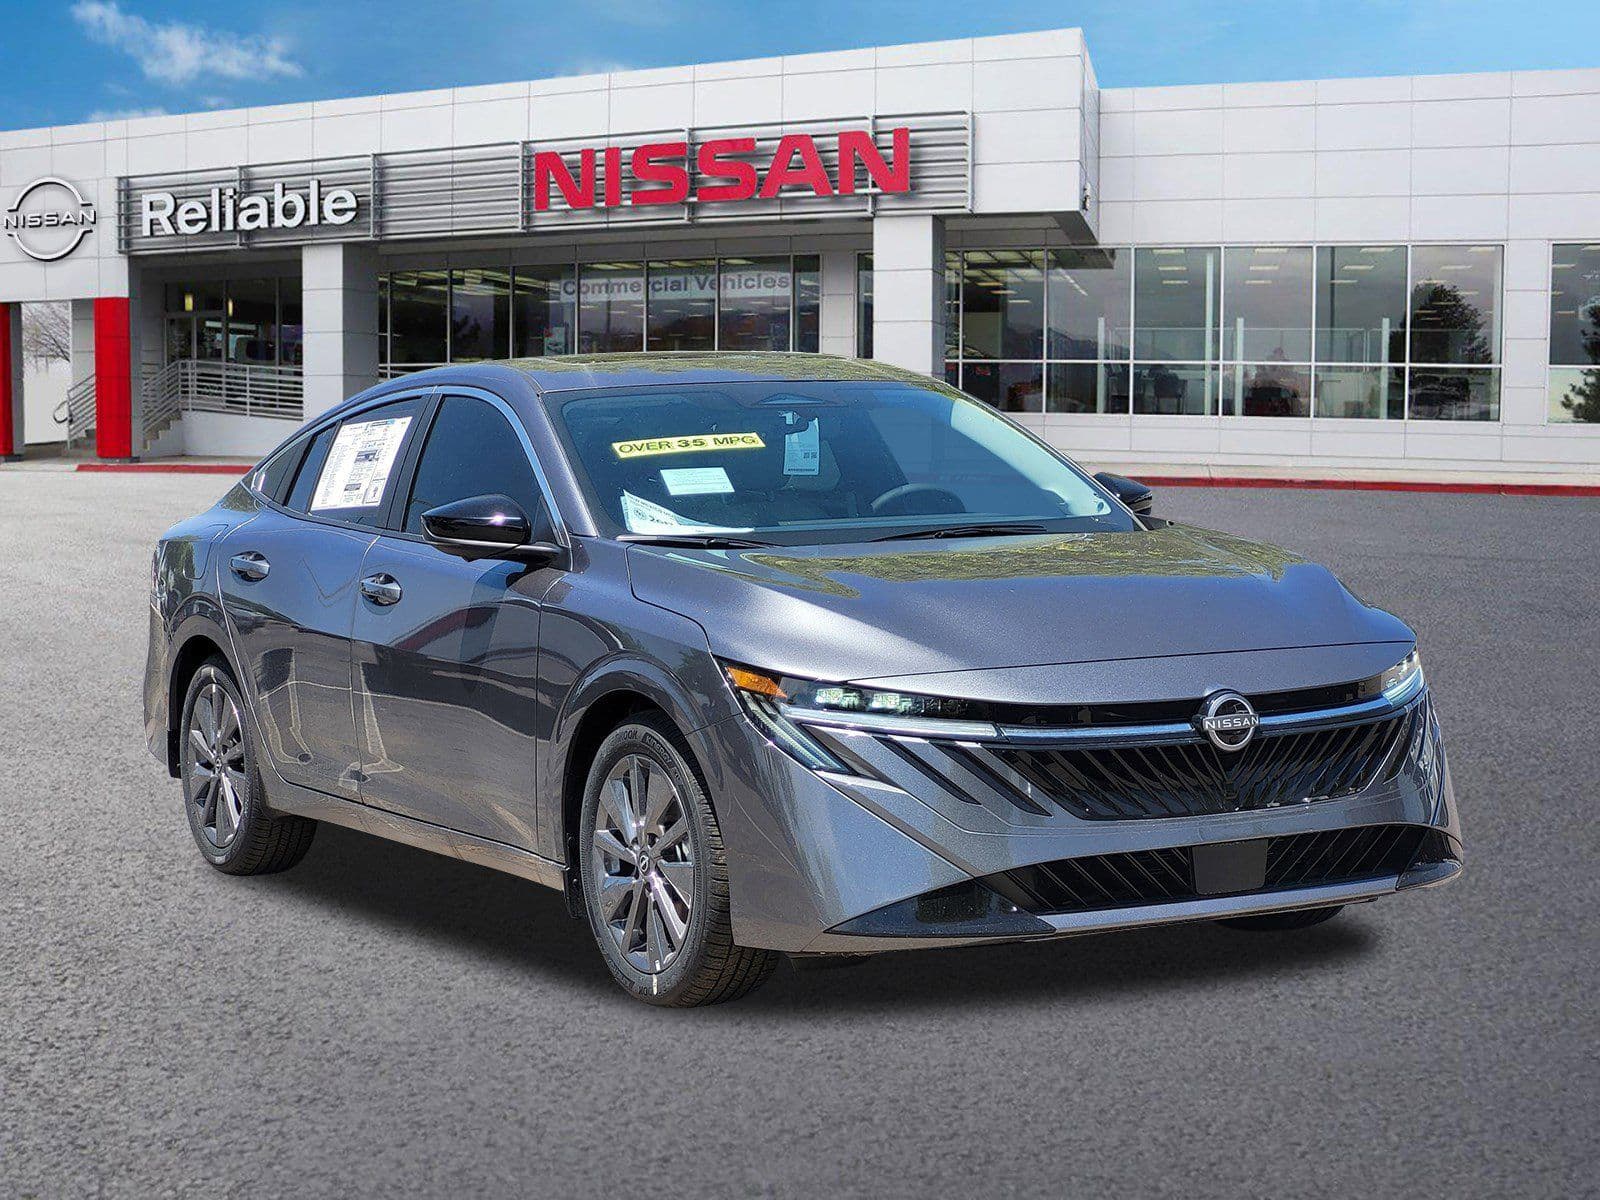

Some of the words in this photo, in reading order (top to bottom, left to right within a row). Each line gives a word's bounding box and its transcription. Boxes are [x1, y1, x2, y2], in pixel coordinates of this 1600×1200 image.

[534, 127, 911, 211] NISSAN
[4, 209, 97, 231] NISSAN
[142, 180, 359, 237] Reliable
[563, 277, 688, 297] Commecial
[692, 273, 790, 292] Vehicles
[618, 440, 673, 455] OVER
[677, 438, 706, 449] 35
[712, 435, 757, 447] MPG
[1205, 715, 1259, 730] NISSAN
